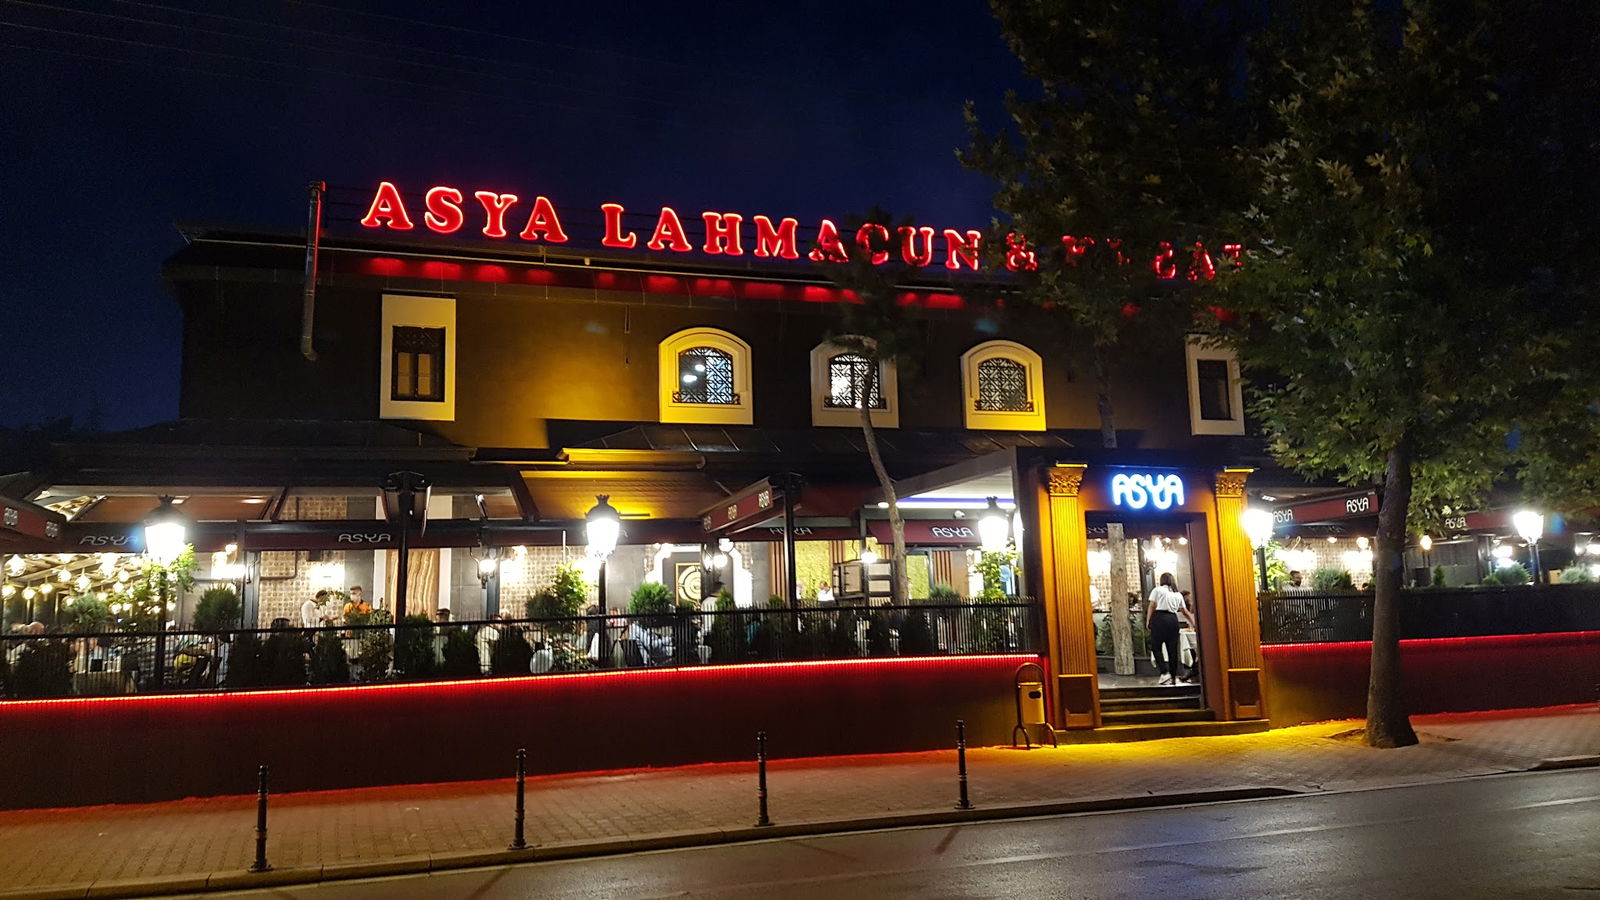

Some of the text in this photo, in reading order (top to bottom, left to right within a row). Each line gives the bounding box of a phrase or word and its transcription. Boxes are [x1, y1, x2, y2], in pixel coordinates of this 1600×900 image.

[360, 181, 569, 243] ASYA
[600, 204, 983, 272] LAHMACUN
[1004, 232, 1038, 272] &
[1112, 473, 1185, 510] ASYA
[1346, 497, 1370, 513] ASYA
[1273, 508, 1294, 523] ASYA
[338, 533, 392, 543] ASYA
[931, 527, 975, 538] ASYA
[79, 535, 138, 546] ASYA
